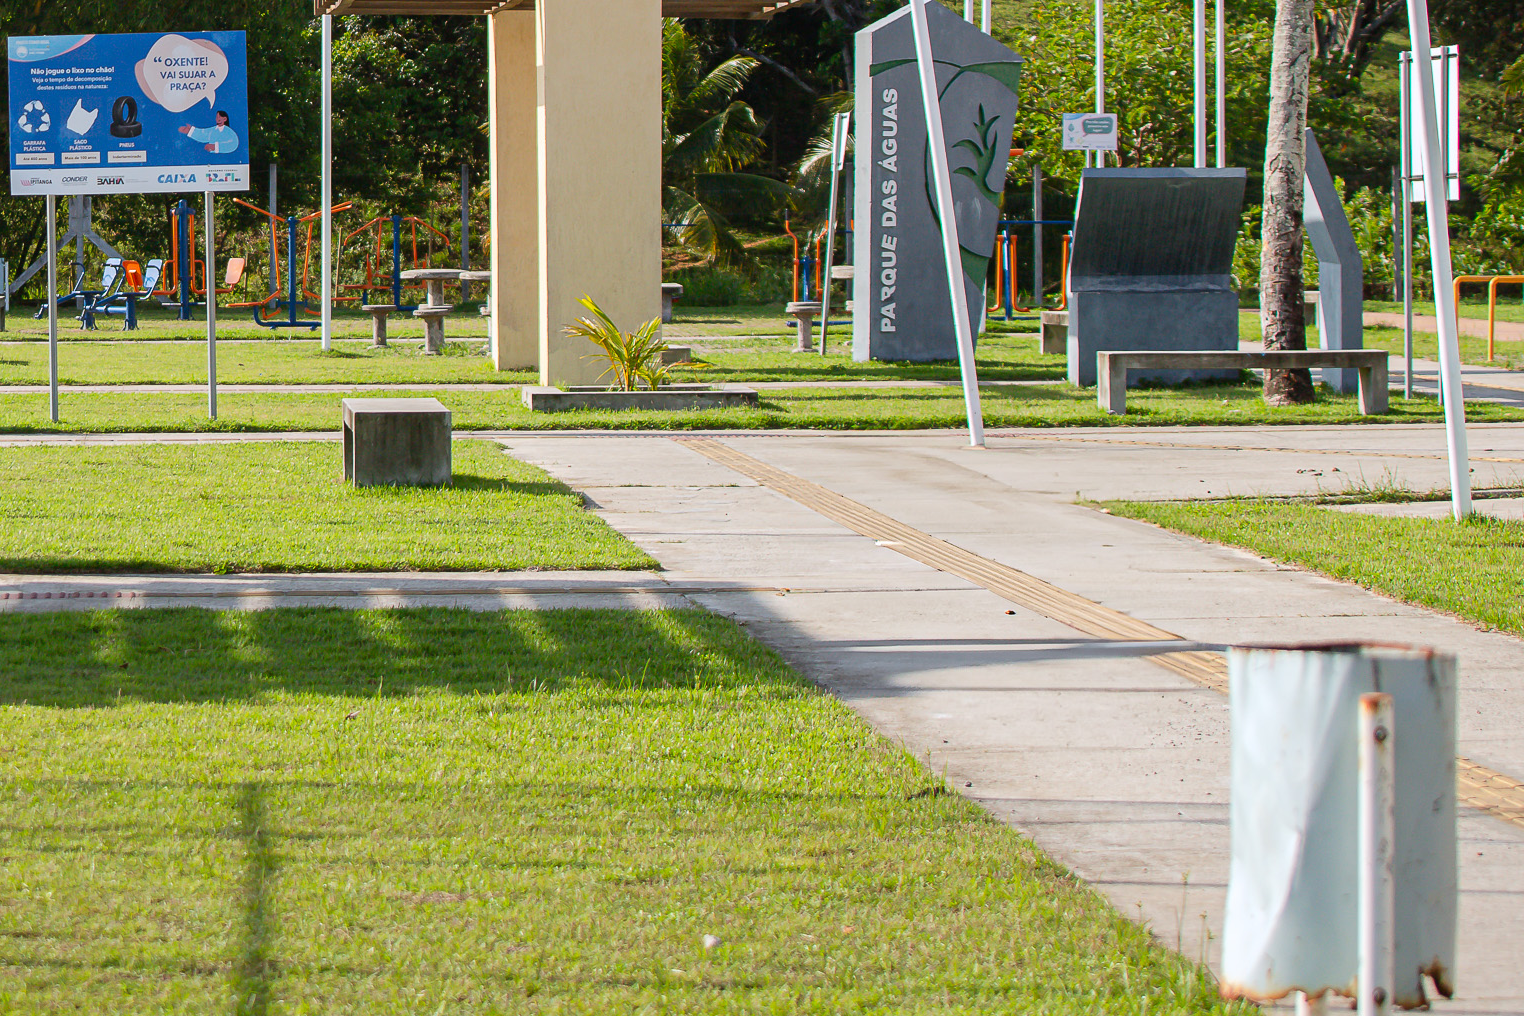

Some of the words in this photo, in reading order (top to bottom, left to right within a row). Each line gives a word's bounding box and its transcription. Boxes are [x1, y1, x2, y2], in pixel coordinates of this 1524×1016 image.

[160, 71, 176, 79] VAI
[178, 70, 207, 78] SUJAR
[170, 82, 206, 92] PRAÇA?
[877, 88, 898, 173] ÁGUAS
[157, 174, 196, 183] CAIXA
[881, 178, 898, 227] DAS
[880, 234, 898, 332] PARQUE
